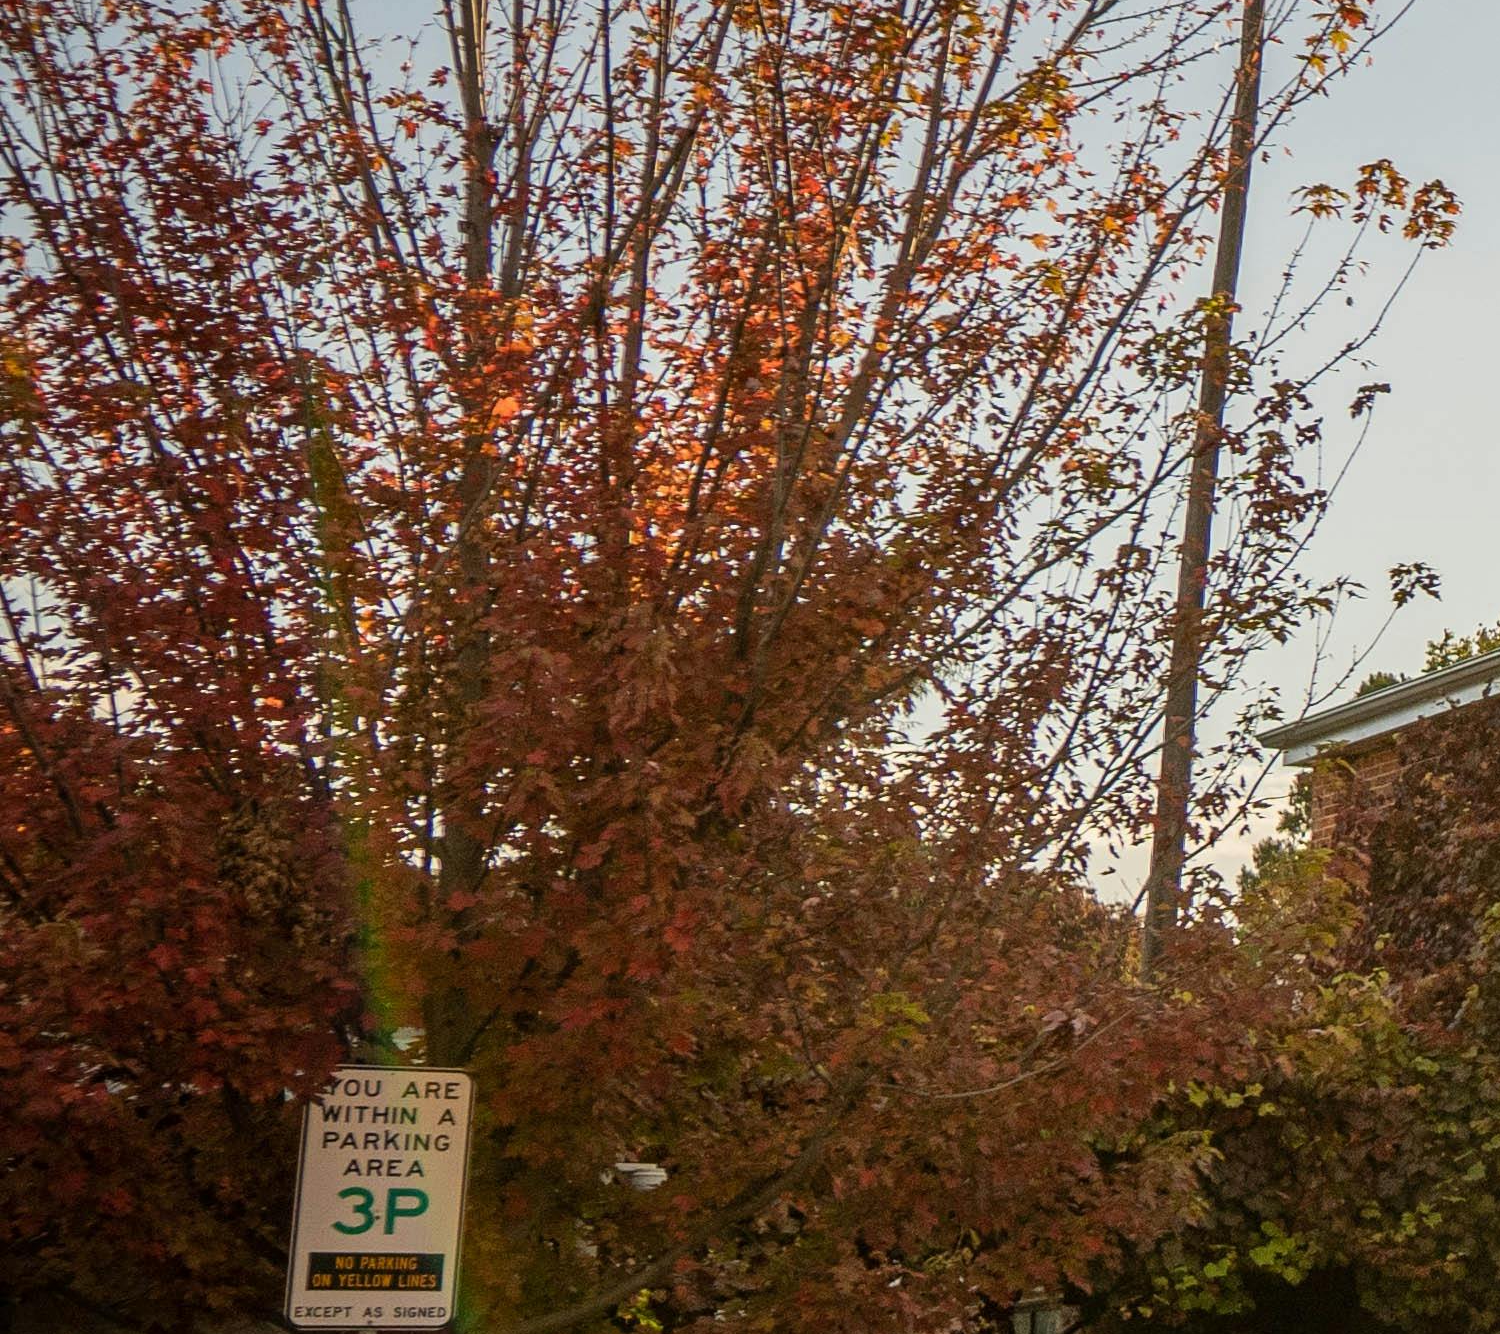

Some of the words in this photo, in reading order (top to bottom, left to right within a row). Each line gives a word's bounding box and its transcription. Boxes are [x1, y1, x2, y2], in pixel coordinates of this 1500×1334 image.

[327, 1079, 382, 1098] YOU
[402, 1082, 460, 1100] ARE
[321, 1106, 417, 1125] WITHIN
[438, 1109, 456, 1126] A
[322, 1131, 451, 1152] PARKING
[343, 1159, 425, 1178] AREA
[331, 1186, 430, 1236] 3P
[335, 1256, 353, 1270] NO
[359, 1256, 417, 1270] PARKING
[312, 1273, 332, 1287] ON
[338, 1274, 392, 1287] YELLOW
[398, 1275, 437, 1288] LINES
[294, 1306, 352, 1318] EXCEPT
[362, 1306, 383, 1319] AS
[393, 1306, 447, 1319] SIGNED
